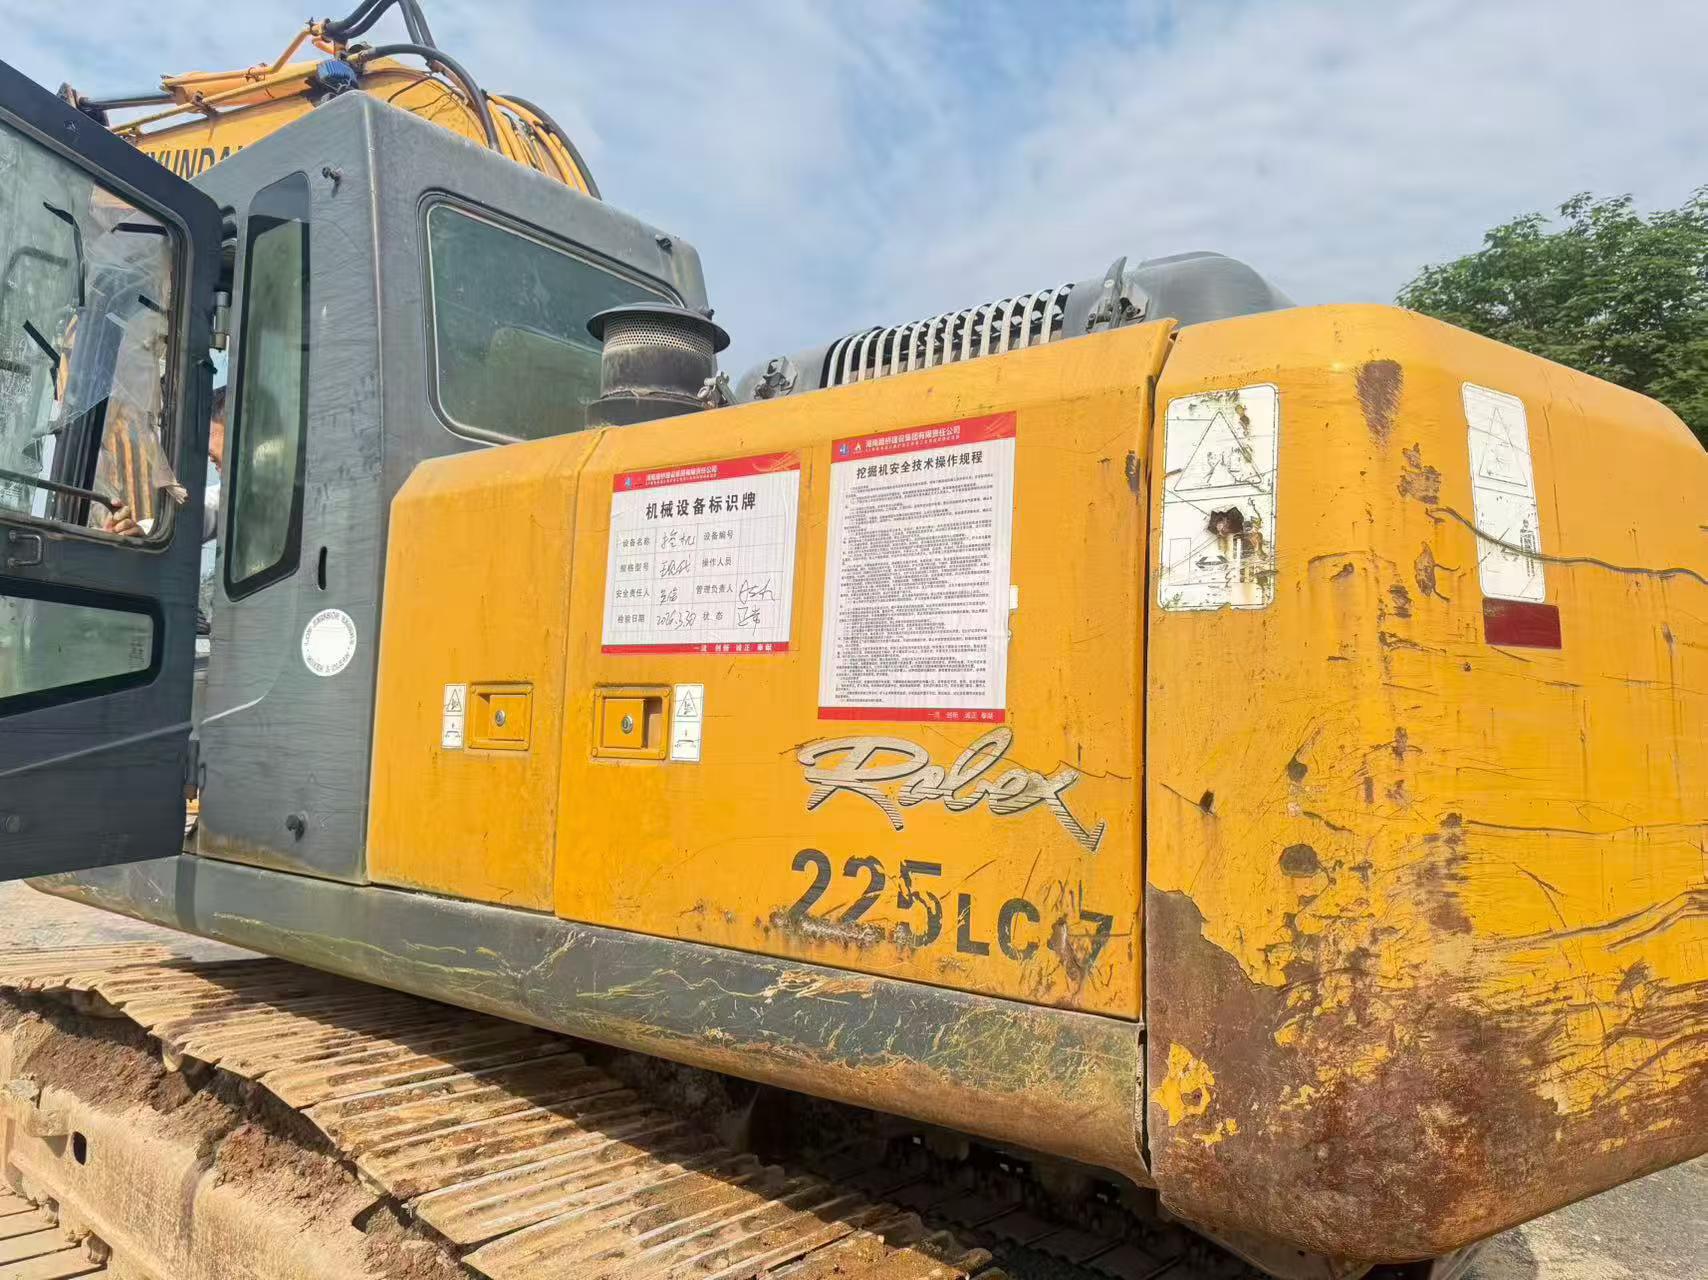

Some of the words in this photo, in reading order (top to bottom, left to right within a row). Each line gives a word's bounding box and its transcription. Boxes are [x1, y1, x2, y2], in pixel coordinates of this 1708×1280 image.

[856, 451, 983, 479] 挖掘机安全技术操作规程
[645, 492, 756, 520] 机械设备标识牌
[703, 530, 734, 541] 设备编号
[622, 537, 650, 548] 设备名称
[620, 562, 649, 572] 规格型号
[702, 556, 732, 568] 操作人员
[616, 588, 650, 599] 安全责任人
[696, 585, 733, 595] 管理负责人
[617, 614, 645, 624] 检验日期
[789, 848, 1115, 970] 225LC7
